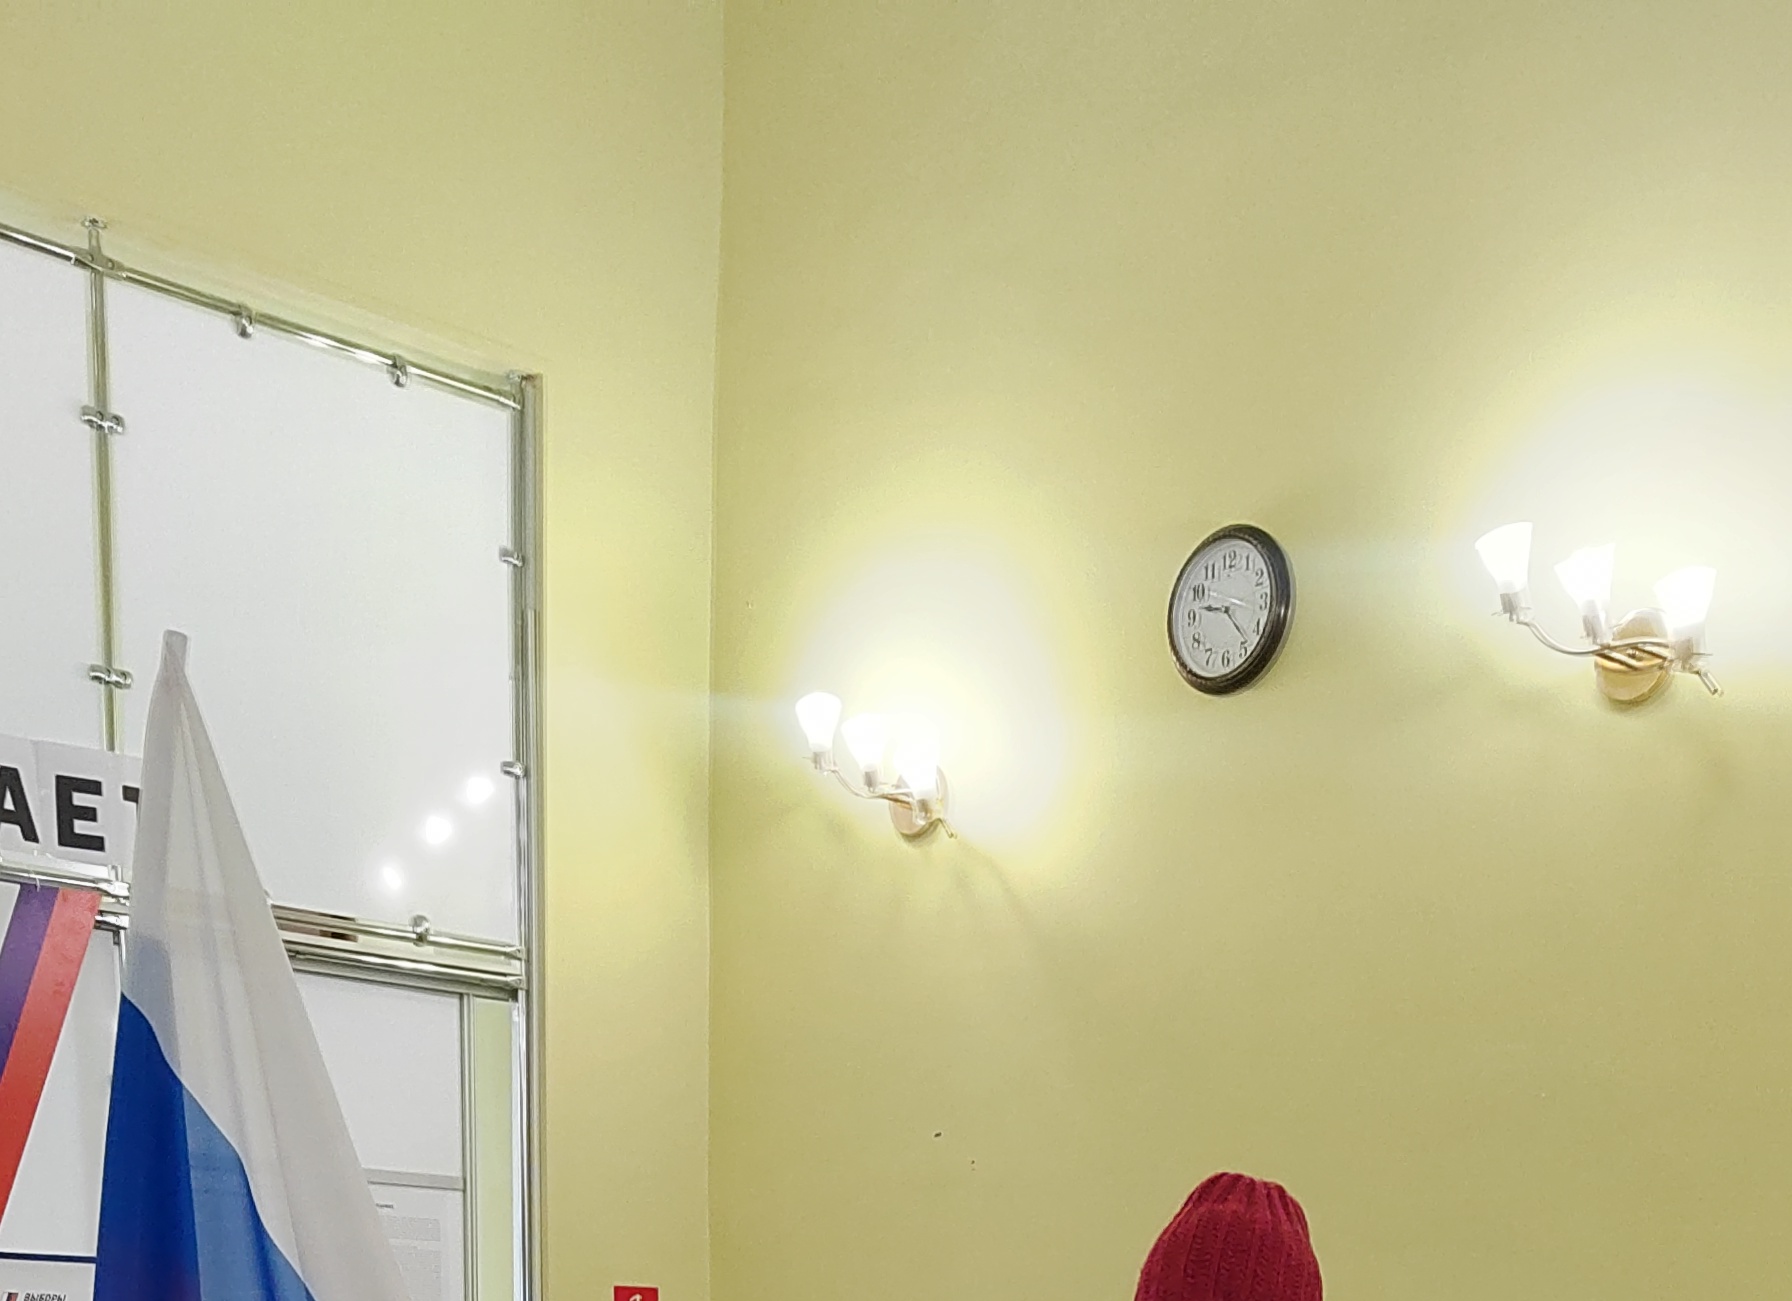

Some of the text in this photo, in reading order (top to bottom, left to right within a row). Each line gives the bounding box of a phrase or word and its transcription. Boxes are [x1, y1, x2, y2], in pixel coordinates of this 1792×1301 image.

[1222, 550, 1236, 570] 12
[1244, 553, 1250, 571] 1
[1204, 562, 1216, 581] 11
[1255, 569, 1264, 586] 2
[1192, 583, 1205, 601] 10
[1259, 593, 1268, 610] 3
[1187, 609, 1196, 627] 9
[1252, 618, 1261, 636] 4
[1191, 633, 1201, 649] 8
[1204, 648, 1213, 667] 7
[1221, 650, 1231, 668] 6
